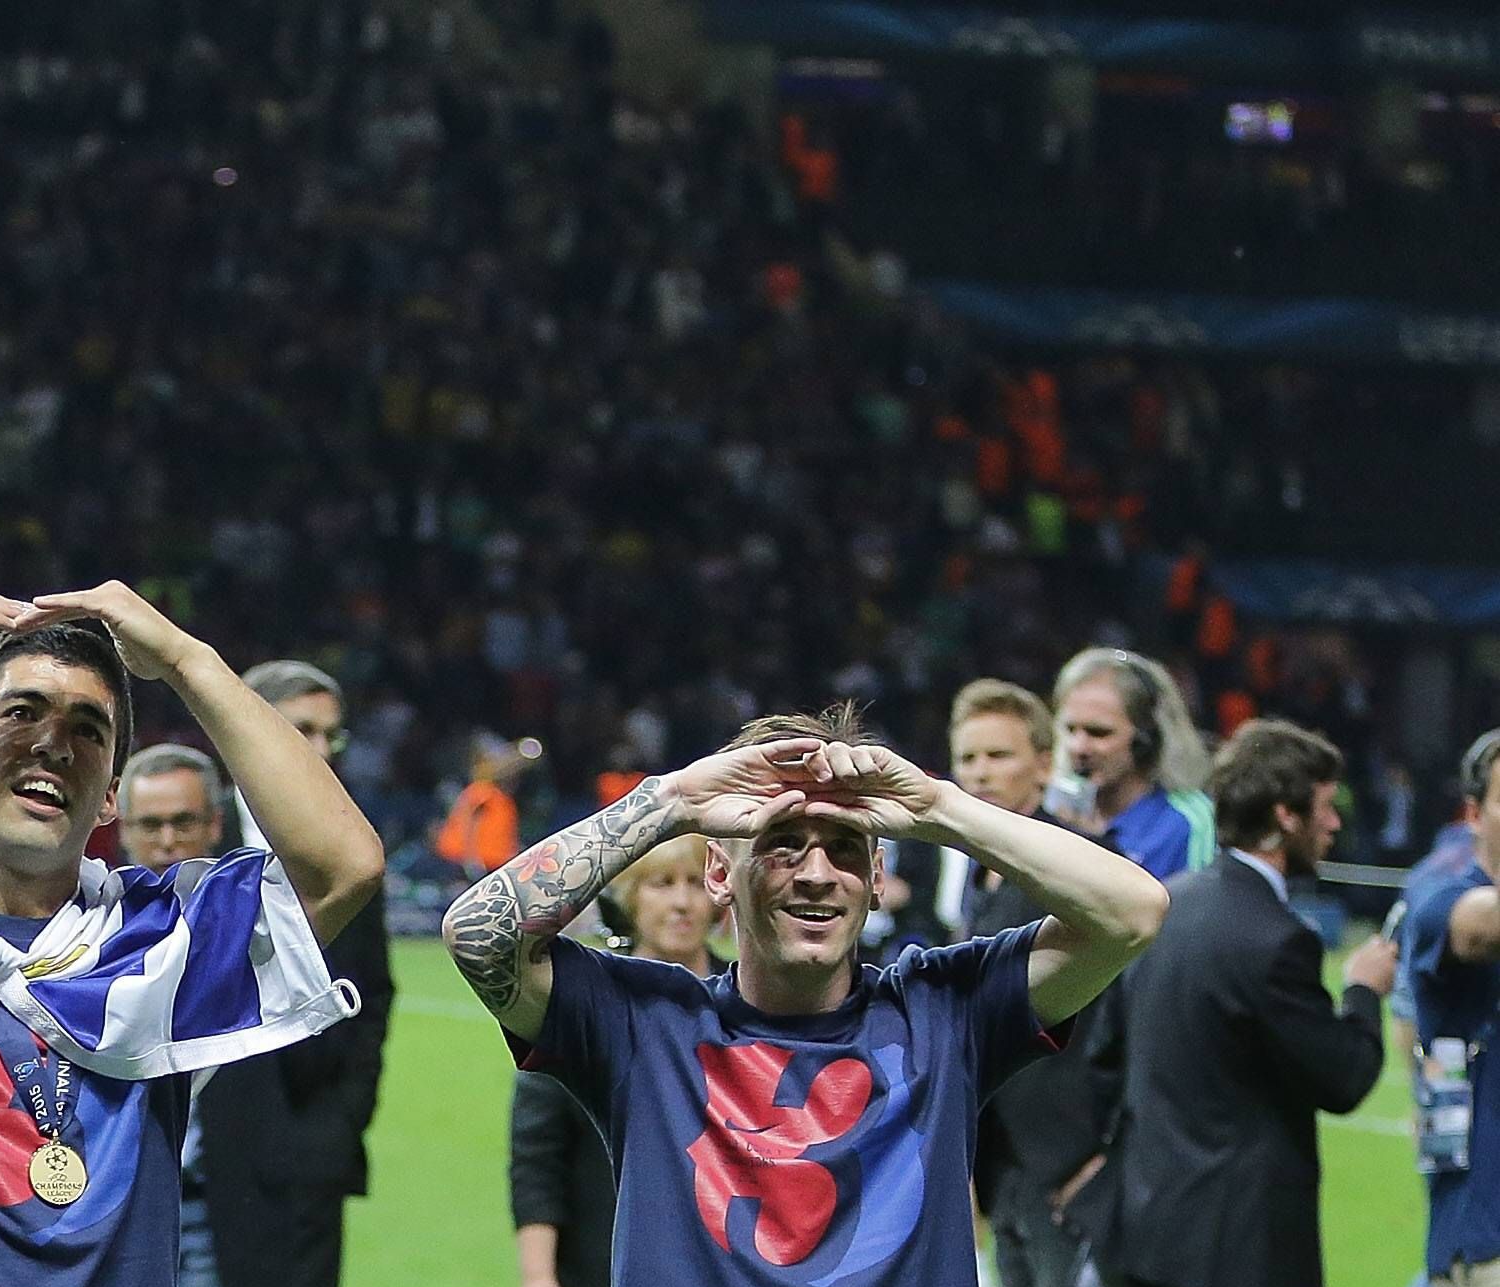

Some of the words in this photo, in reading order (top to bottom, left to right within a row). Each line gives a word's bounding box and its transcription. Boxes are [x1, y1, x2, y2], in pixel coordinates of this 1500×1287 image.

[56, 1060, 70, 1097] INAL
[29, 1084, 48, 1120] 2015
[34, 1182, 83, 1190] CHAMPIONS
